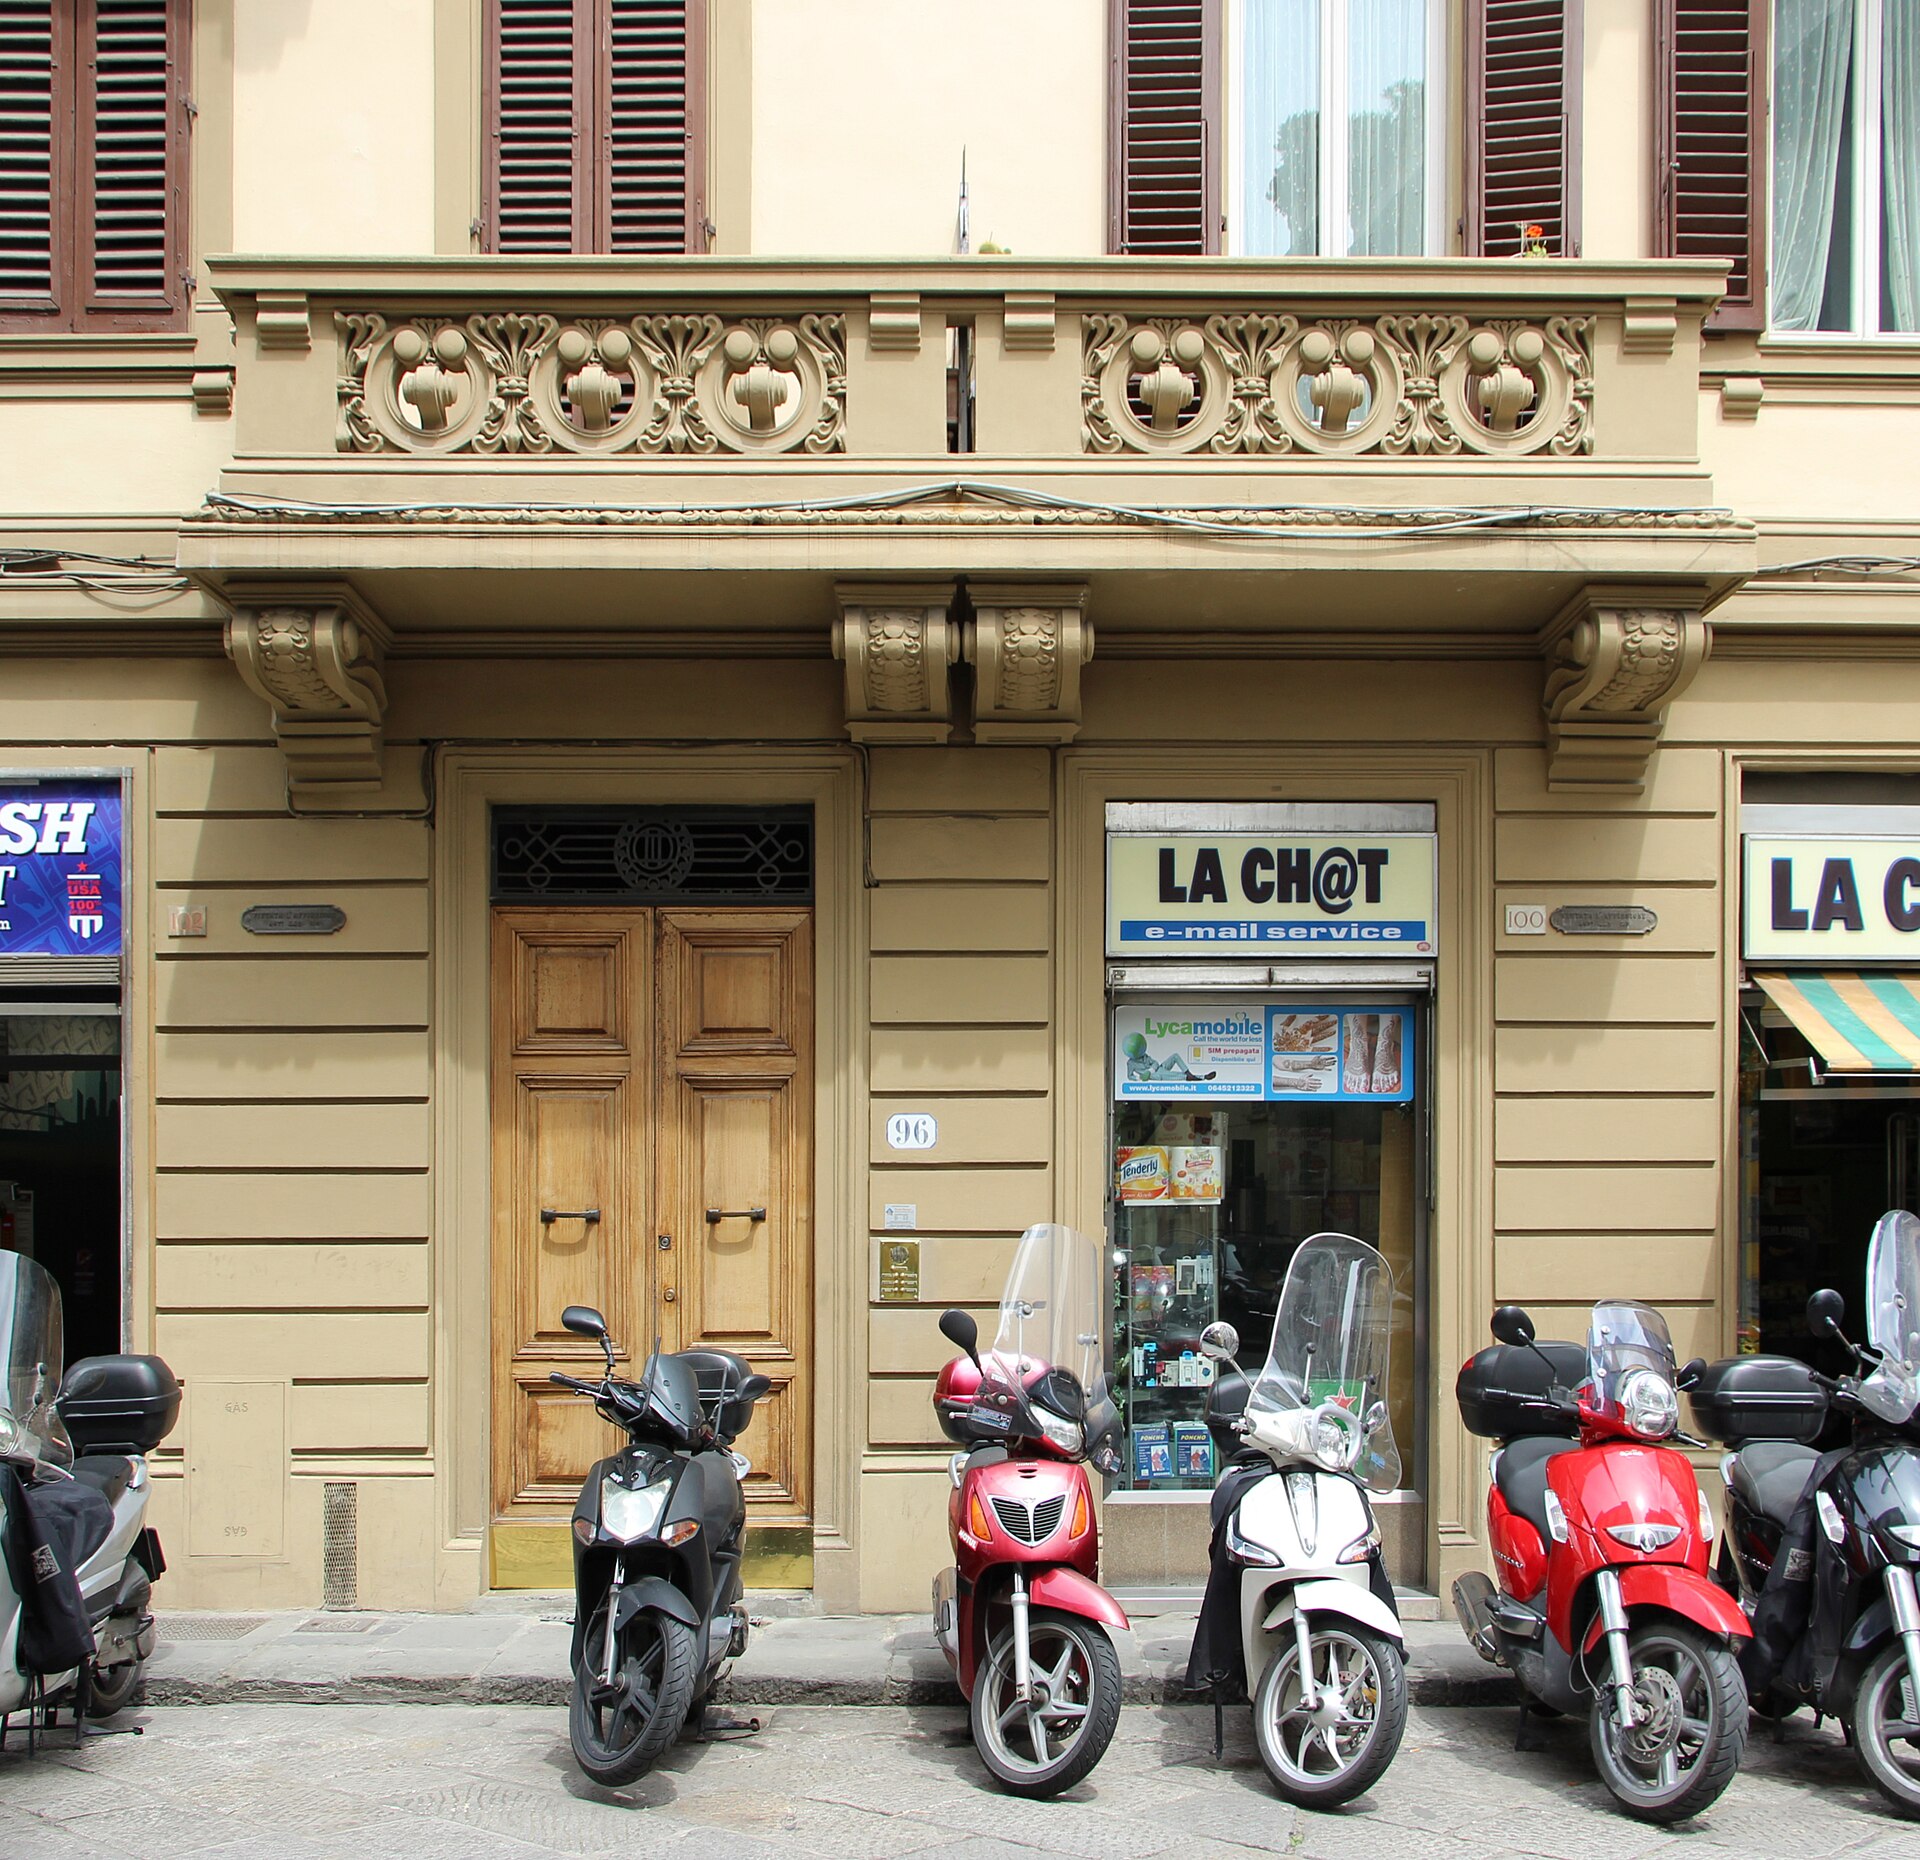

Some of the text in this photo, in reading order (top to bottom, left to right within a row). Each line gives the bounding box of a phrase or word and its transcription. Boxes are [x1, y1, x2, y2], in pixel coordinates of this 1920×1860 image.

[1158, 846, 1389, 914] LA CH@T
[67, 885, 100, 895] USA
[1770, 857, 1865, 931] LA
[170, 910, 204, 932] 102
[1508, 911, 1544, 929] 100
[1145, 923, 1402, 939] e-mail service
[1145, 1017, 1262, 1038] Lycamobile
[1129, 1084, 1197, 1093] www.lycamobile.it
[895, 1118, 929, 1145] 96
[1120, 1159, 1158, 1179] Tenderly
[225, 1402, 249, 1413] GAS
[224, 1526, 248, 1537] GAS
